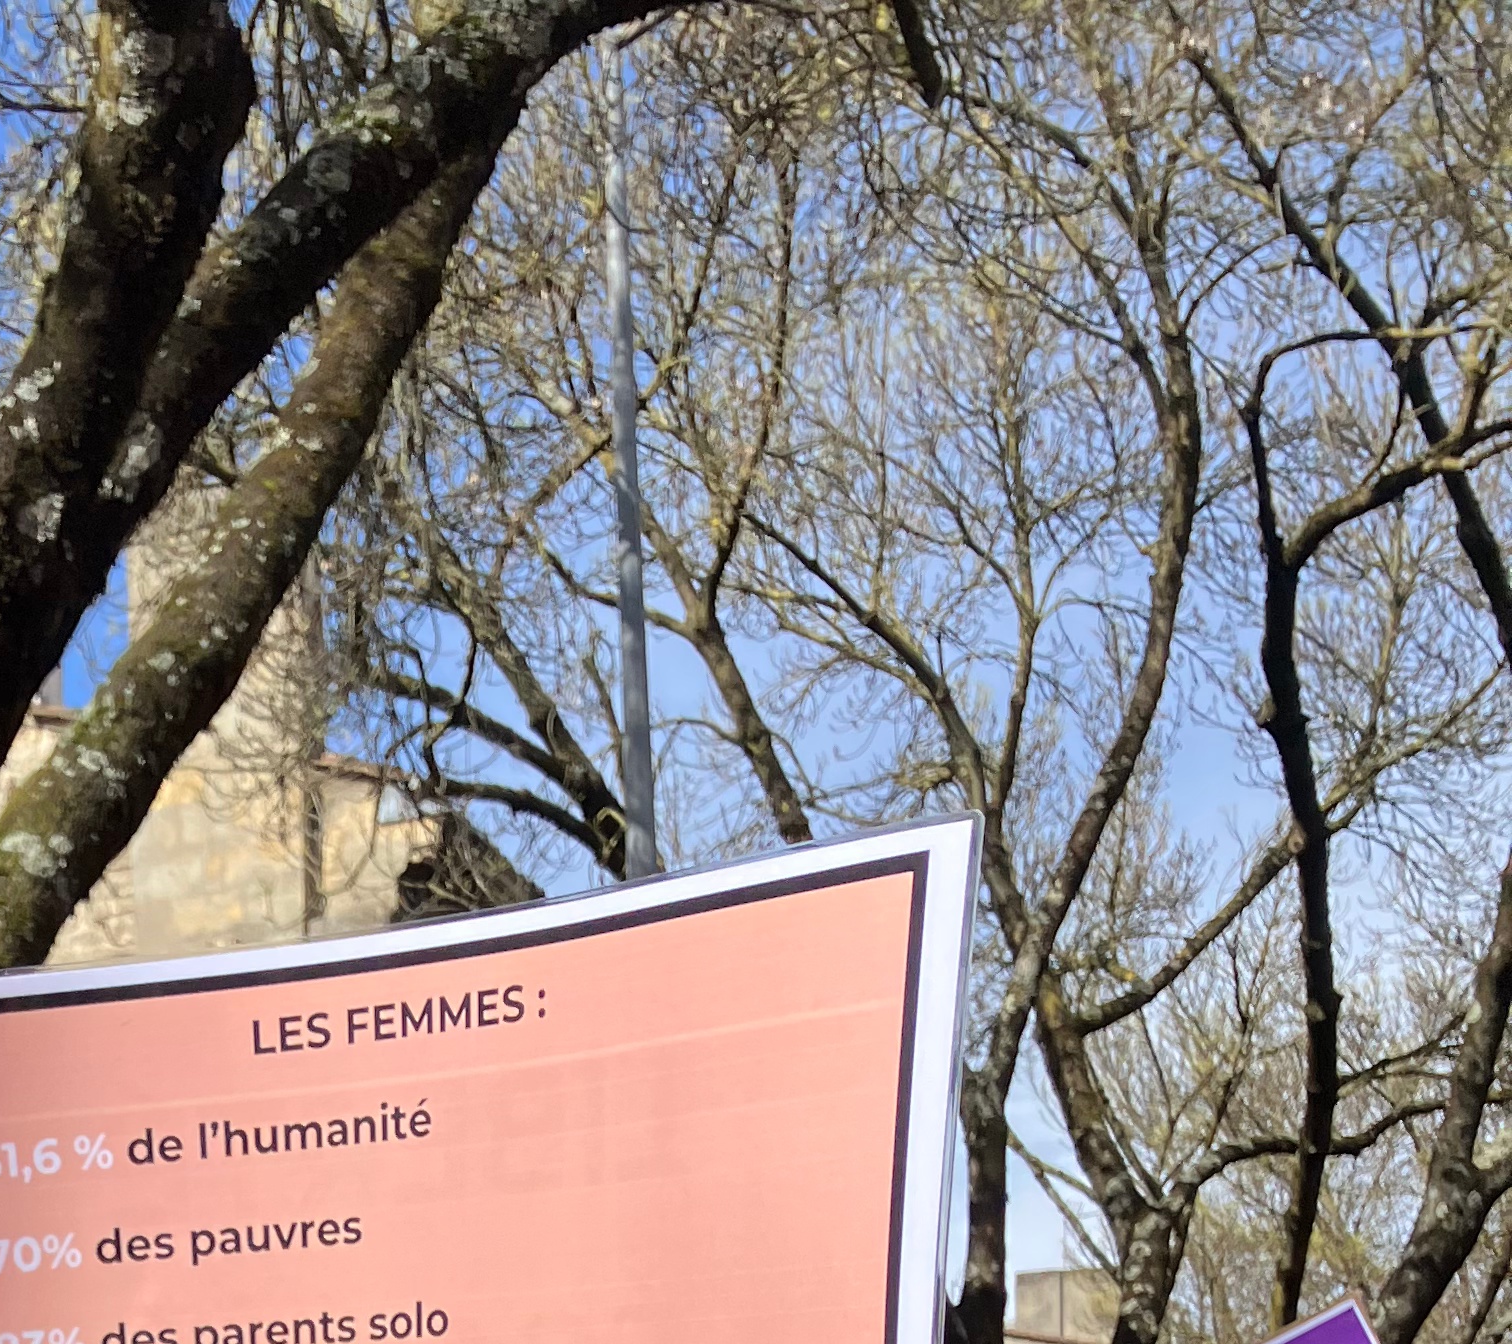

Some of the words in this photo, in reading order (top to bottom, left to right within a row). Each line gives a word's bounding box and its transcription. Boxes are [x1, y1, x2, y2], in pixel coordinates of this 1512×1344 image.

[253, 1013, 331, 1055] LES
[347, 985, 524, 1044] FEMMES
[74, 1134, 113, 1170] %
[128, 1128, 183, 1165] de
[199, 1098, 431, 1159] l'humanité
[96, 1228, 174, 1264] des
[191, 1217, 361, 1266] pauvres
[370, 1301, 448, 1340] solo
